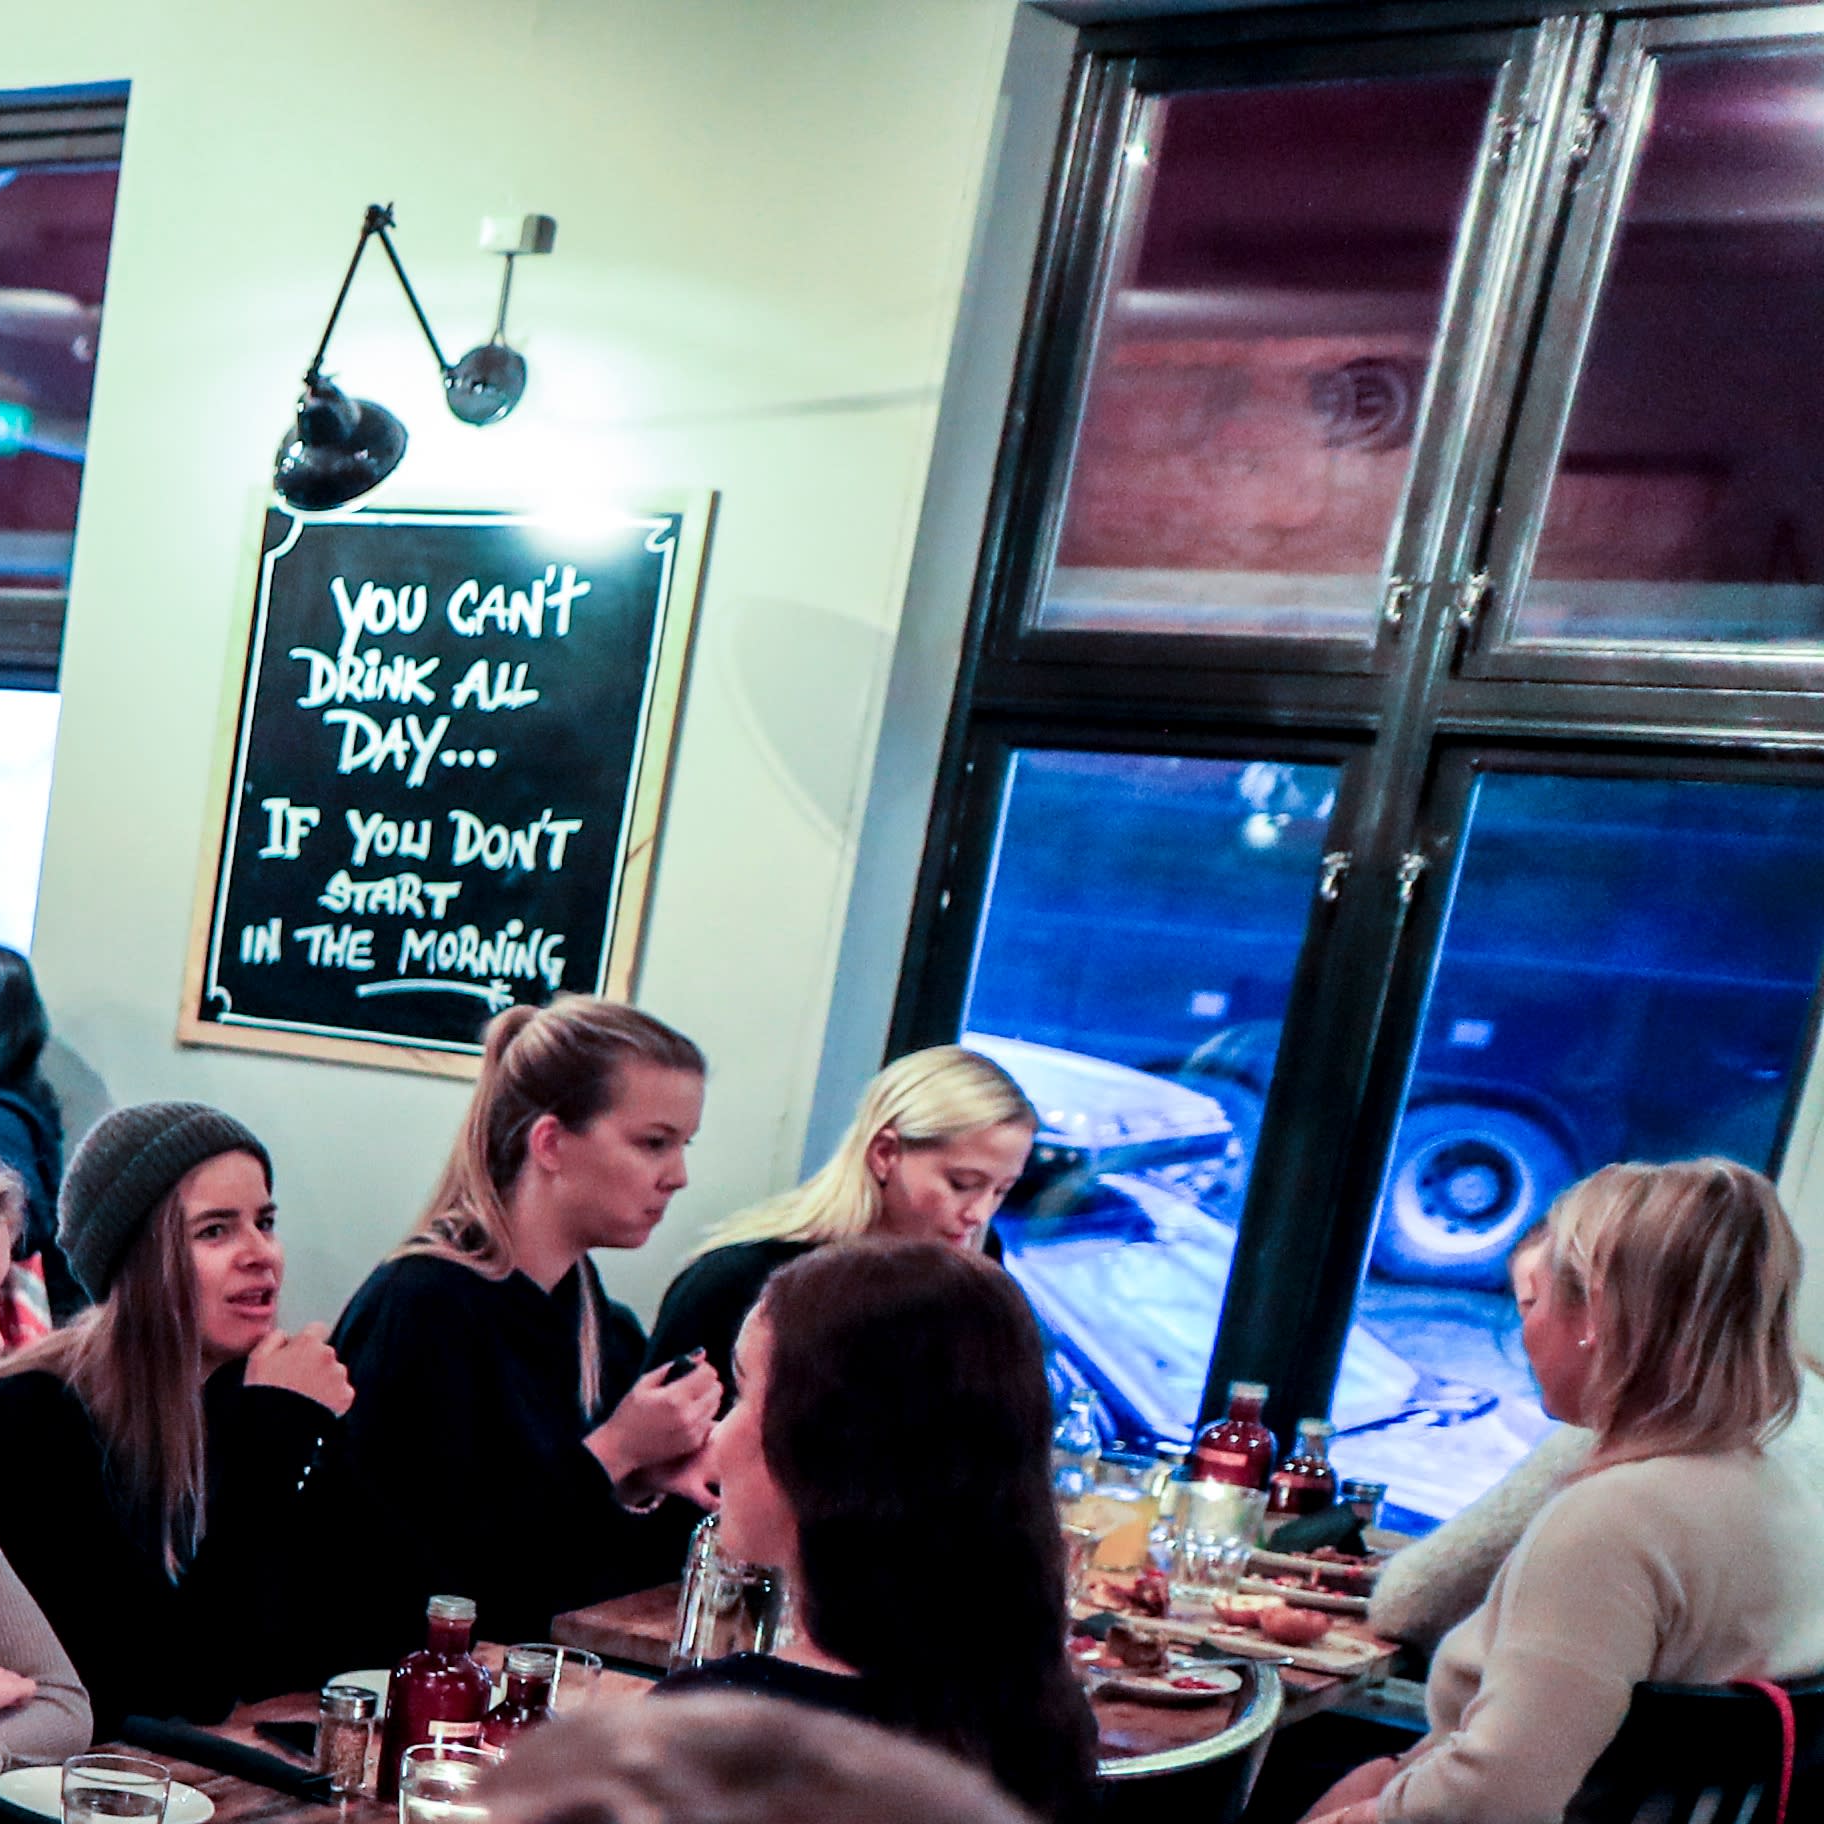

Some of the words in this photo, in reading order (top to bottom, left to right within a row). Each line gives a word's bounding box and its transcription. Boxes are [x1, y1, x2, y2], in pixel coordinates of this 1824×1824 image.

[330, 576, 427, 656] YOU
[447, 564, 591, 638] CAN'T
[453, 658, 539, 712] ALL
[322, 709, 497, 787] DAY...
[258, 798, 321, 860] IF
[345, 809, 432, 867] YOU
[448, 808, 583, 871] DON'T
[317, 869, 462, 919] START
[240, 918, 283, 965] IN
[292, 923, 375, 971] THE
[398, 919, 566, 990] MORNING
